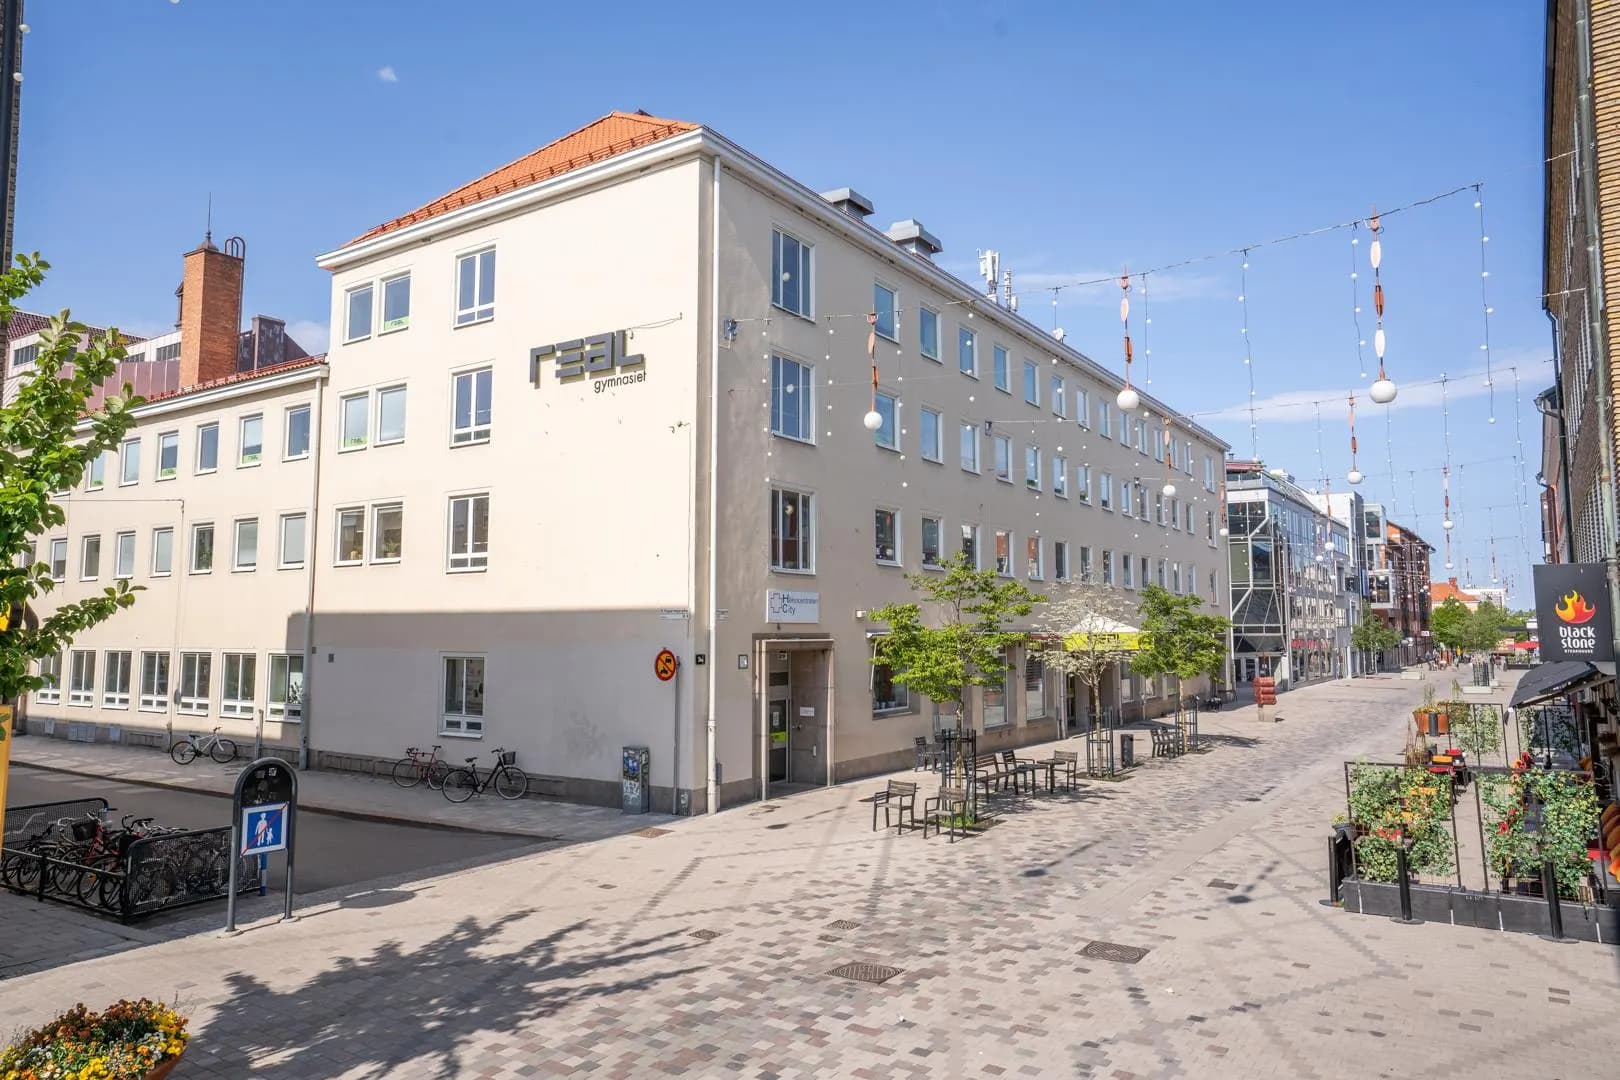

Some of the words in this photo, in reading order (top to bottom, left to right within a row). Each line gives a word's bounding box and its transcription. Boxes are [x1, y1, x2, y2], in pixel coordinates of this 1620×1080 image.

[594, 370, 647, 393] gymnasiet
[782, 603, 796, 615] City
[1559, 626, 1596, 638] black
[1561, 637, 1596, 649] stone
